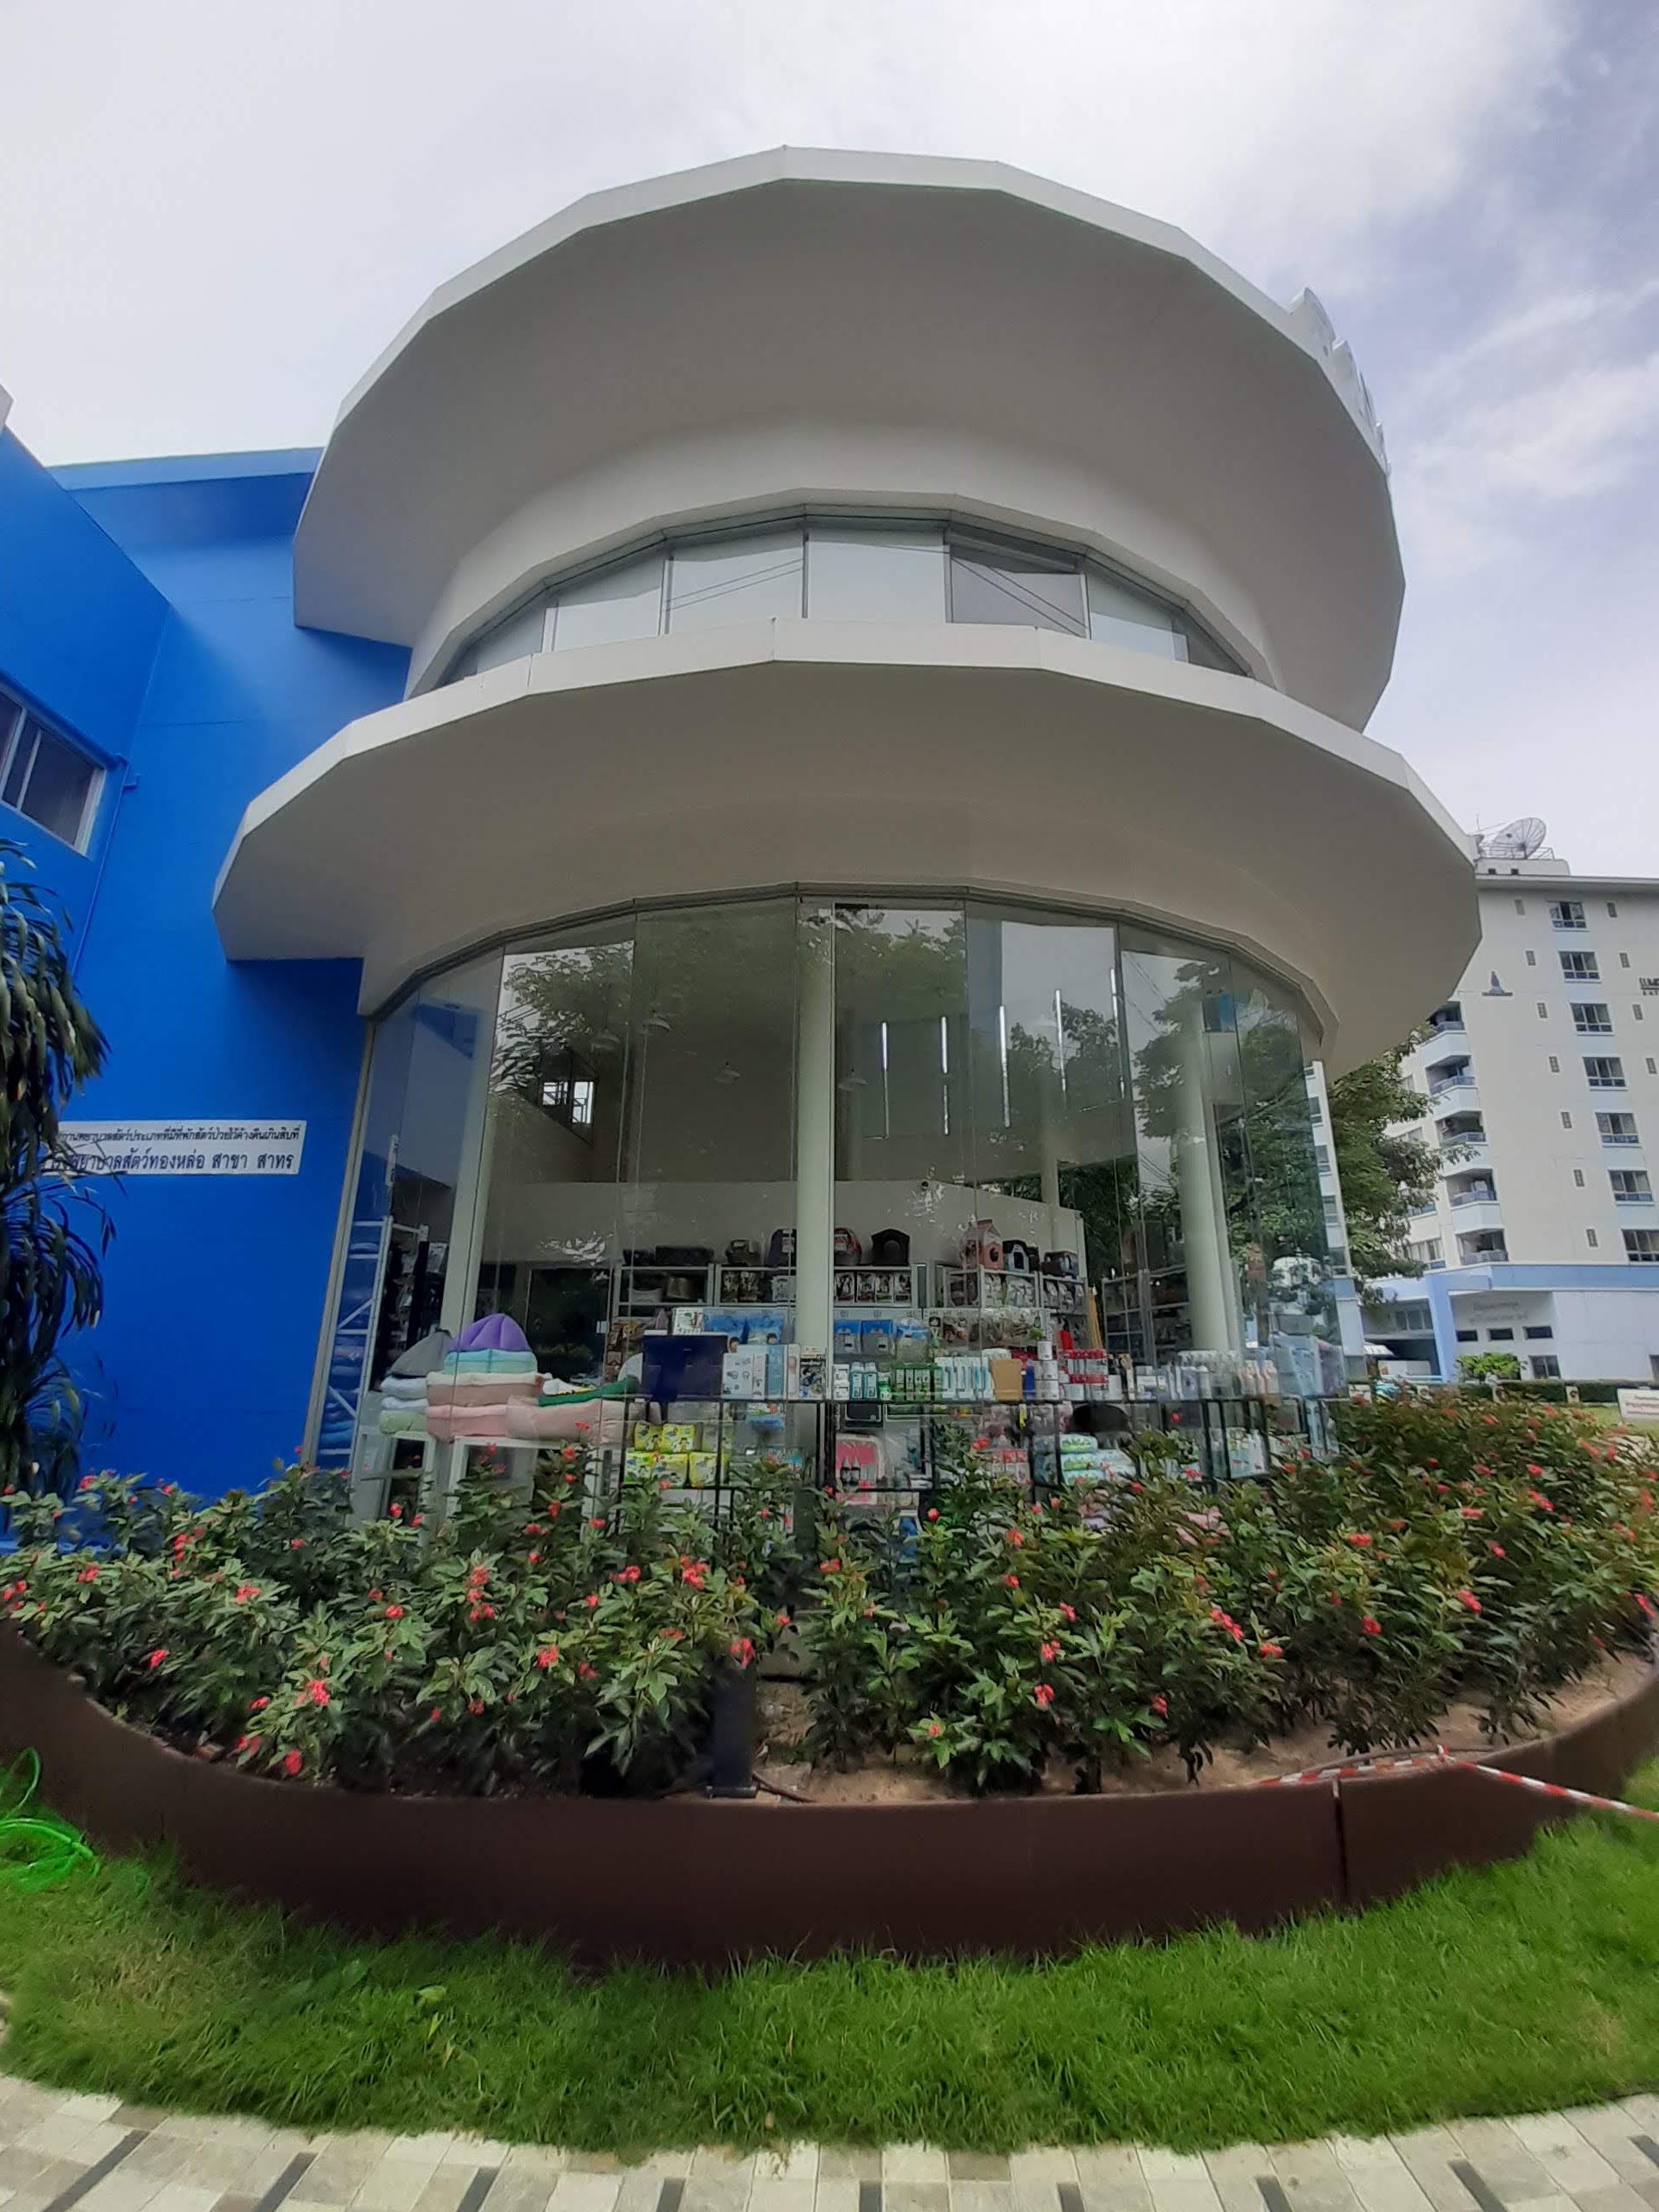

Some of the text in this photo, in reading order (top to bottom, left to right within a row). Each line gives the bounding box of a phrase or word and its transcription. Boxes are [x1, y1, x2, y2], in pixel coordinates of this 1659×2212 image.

[52, 1147, 295, 1170] พยาบาลสัตว์ทองหล่อ สาขา สาทร
